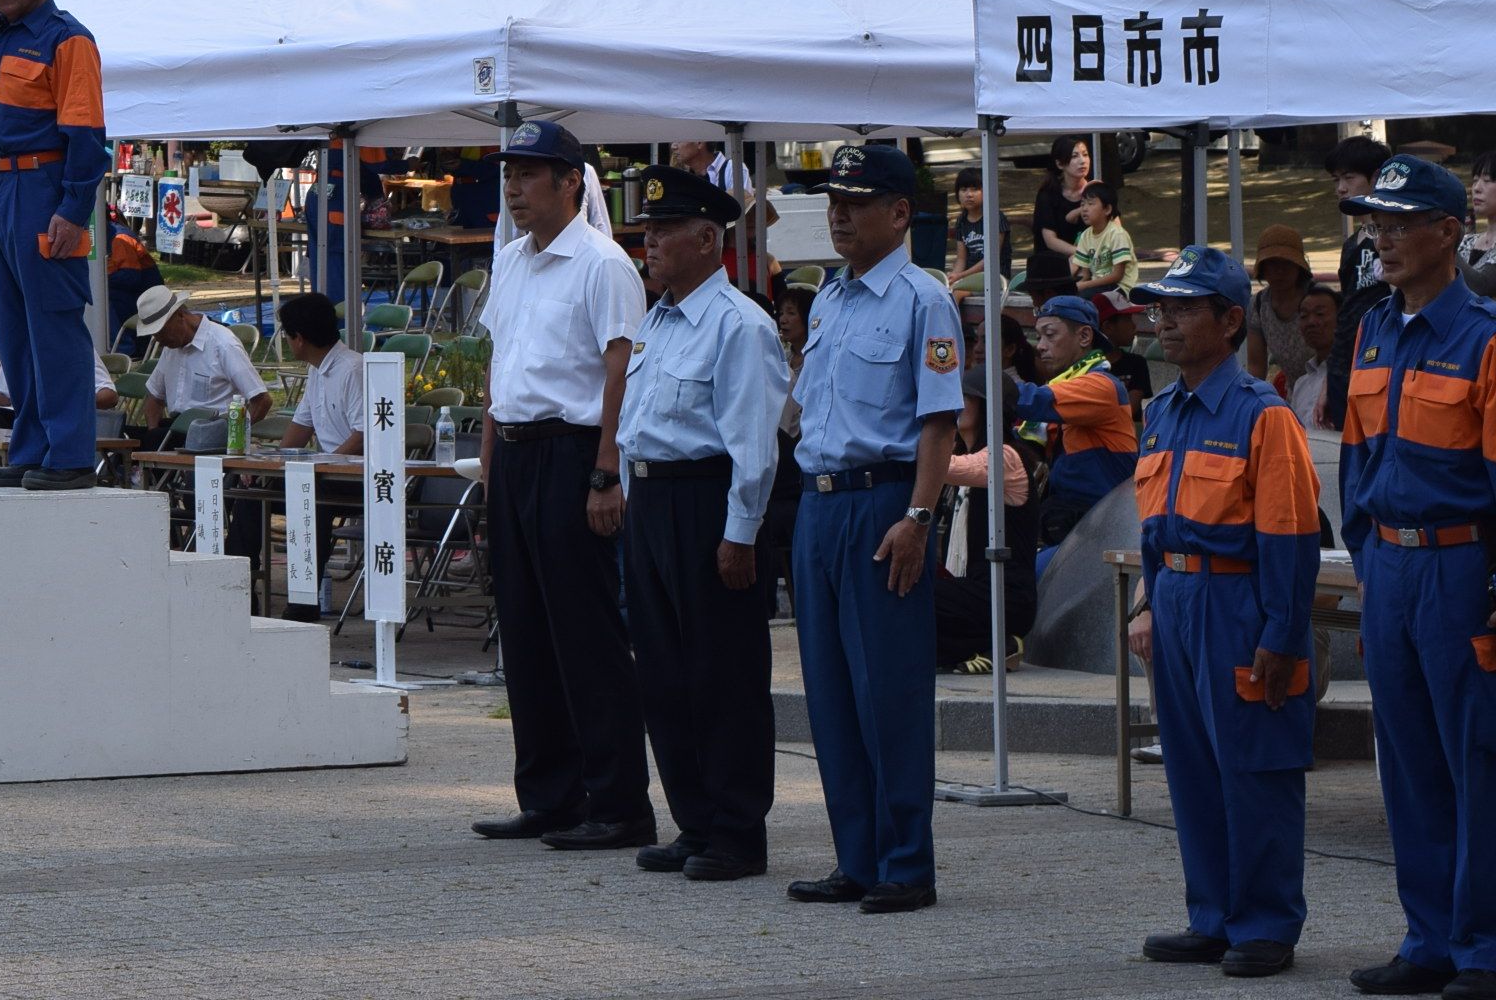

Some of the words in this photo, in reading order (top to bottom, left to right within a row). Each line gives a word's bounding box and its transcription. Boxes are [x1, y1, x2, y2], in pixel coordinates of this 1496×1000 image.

[1015, 8, 1224, 88] 四日市市
[372, 396, 396, 577] 来賓席
